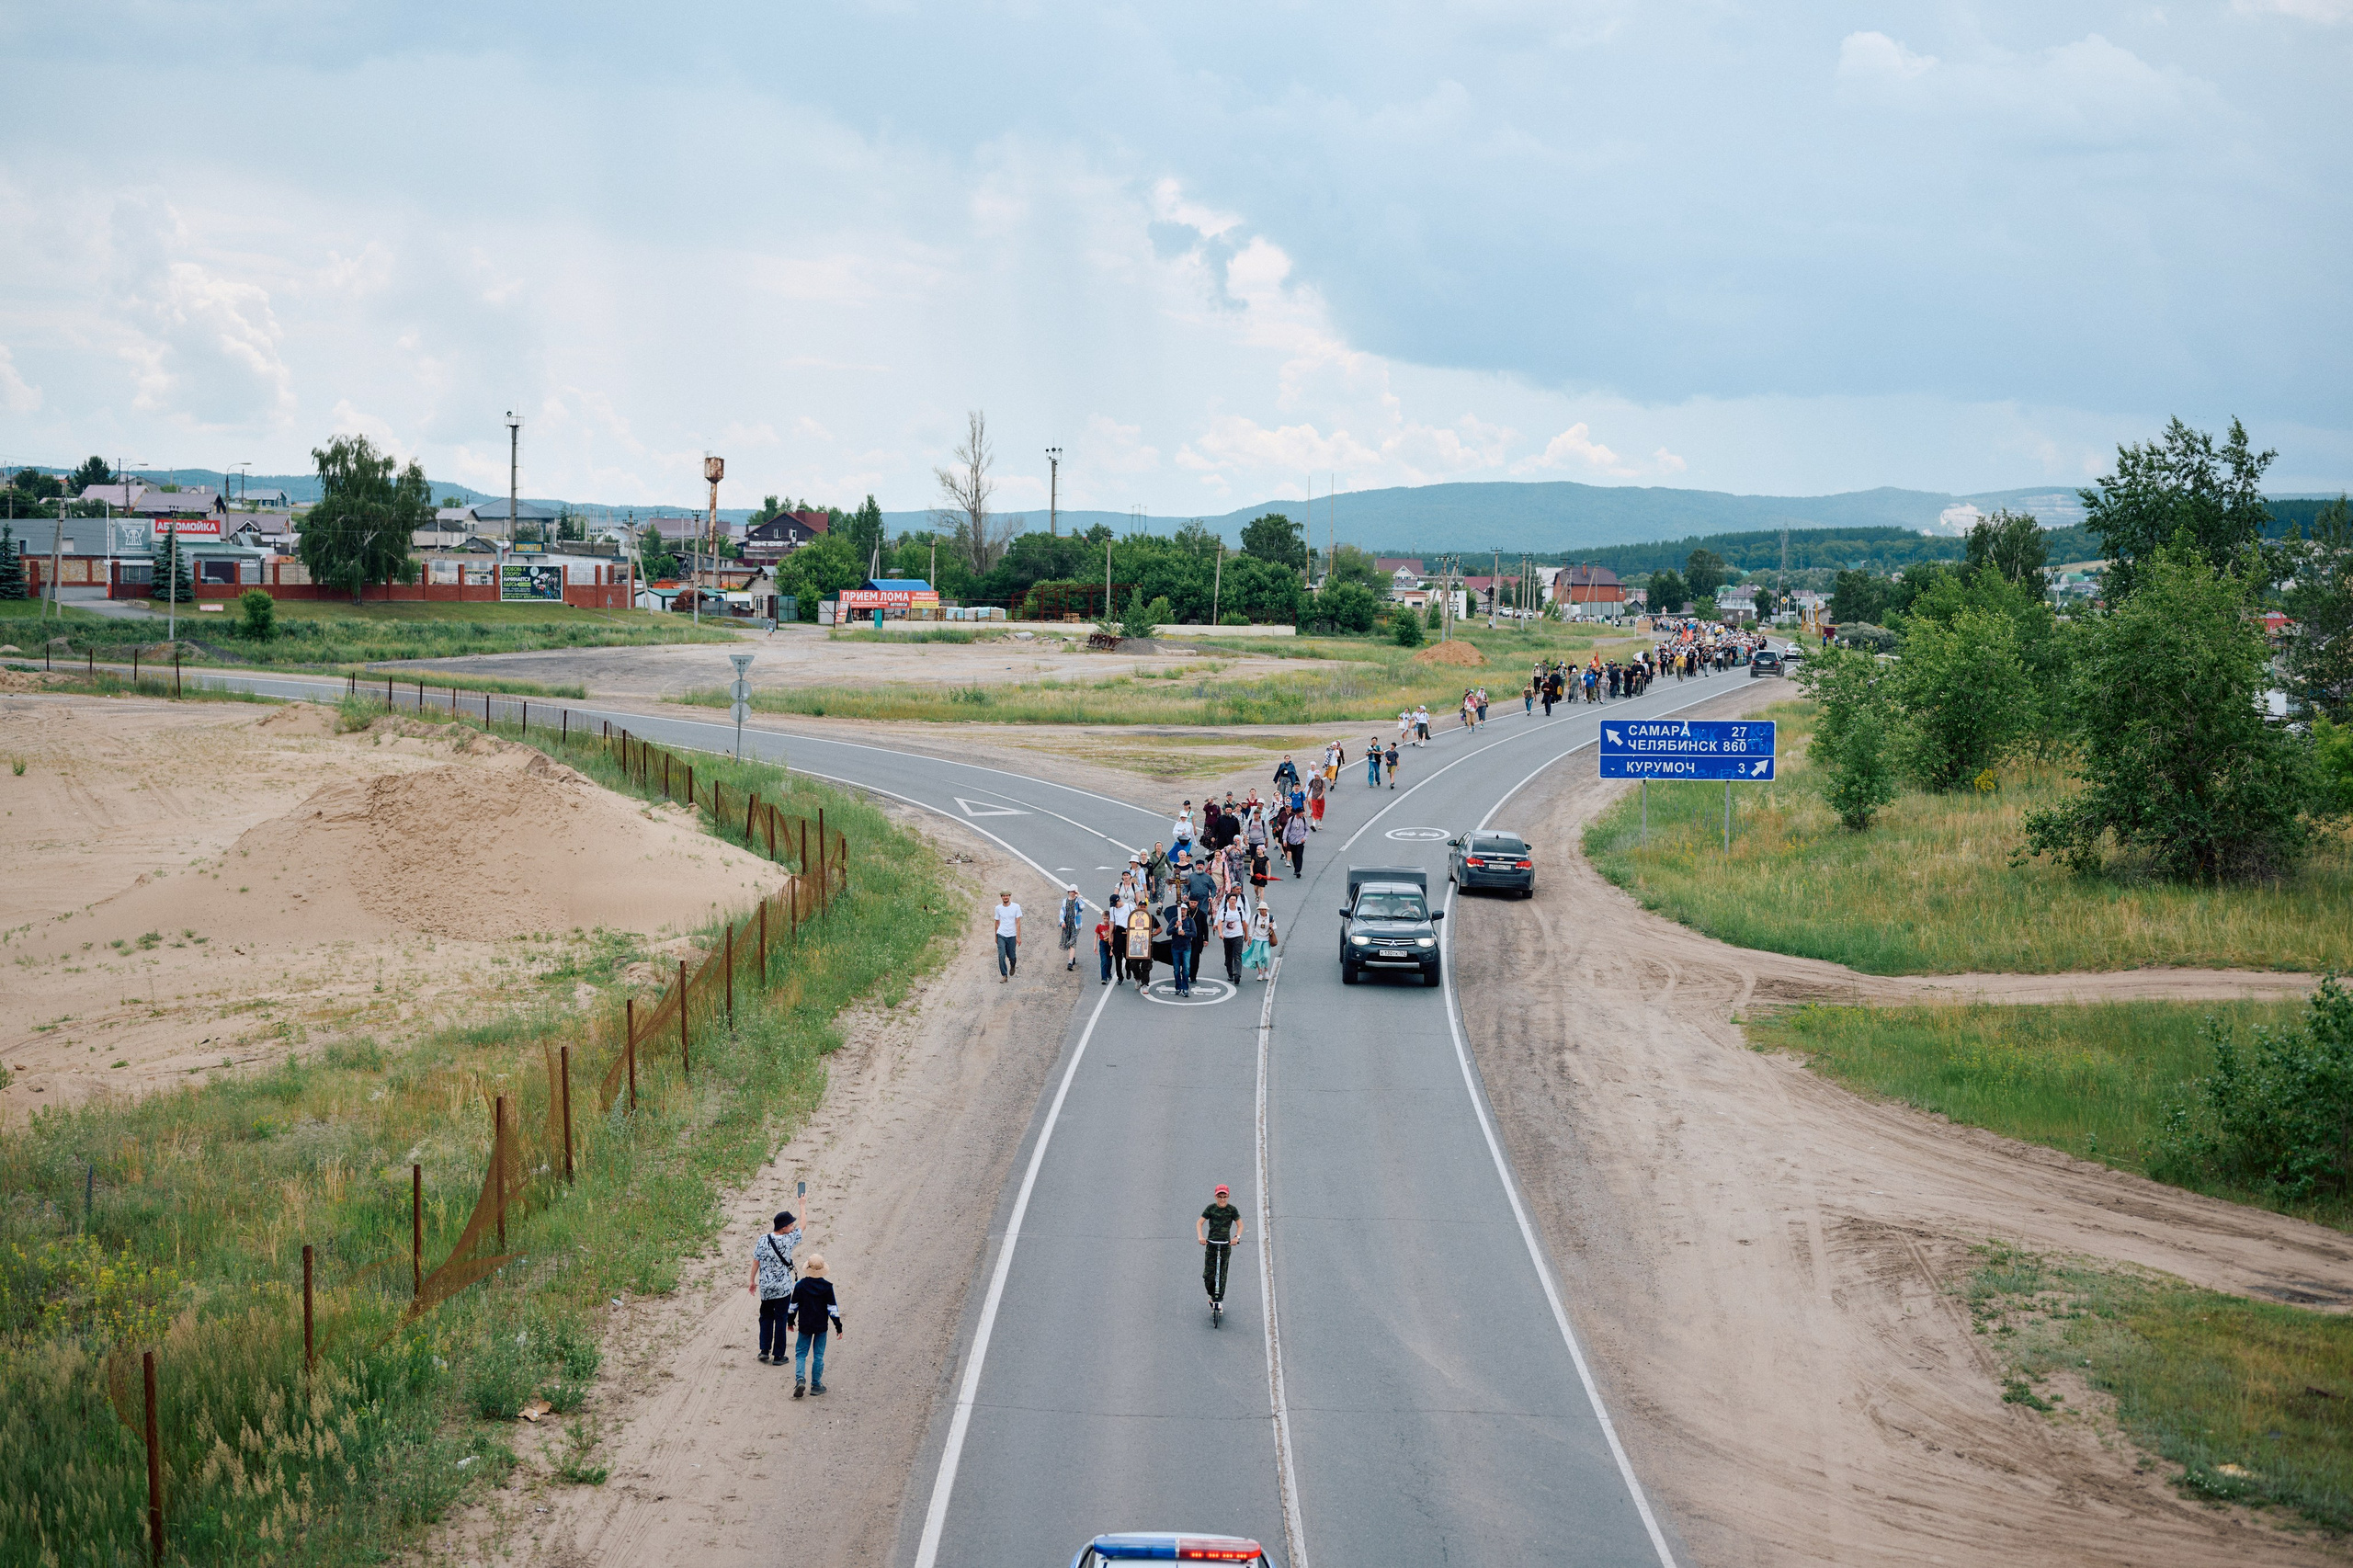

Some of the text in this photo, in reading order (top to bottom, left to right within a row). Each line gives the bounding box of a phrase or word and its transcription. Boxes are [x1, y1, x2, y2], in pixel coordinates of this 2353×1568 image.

[156, 520, 217, 532] АВОМОЙКА
[842, 591, 910, 601] ПРИЕМ ЛОМА
[1628, 724, 1691, 737] САМАРА
[1731, 726, 1747, 737] 27
[1628, 739, 1718, 752] ЧЕЛЯБИНСК
[1722, 741, 1747, 752] 860
[1626, 761, 1745, 774] КУРУМОЧ 3
